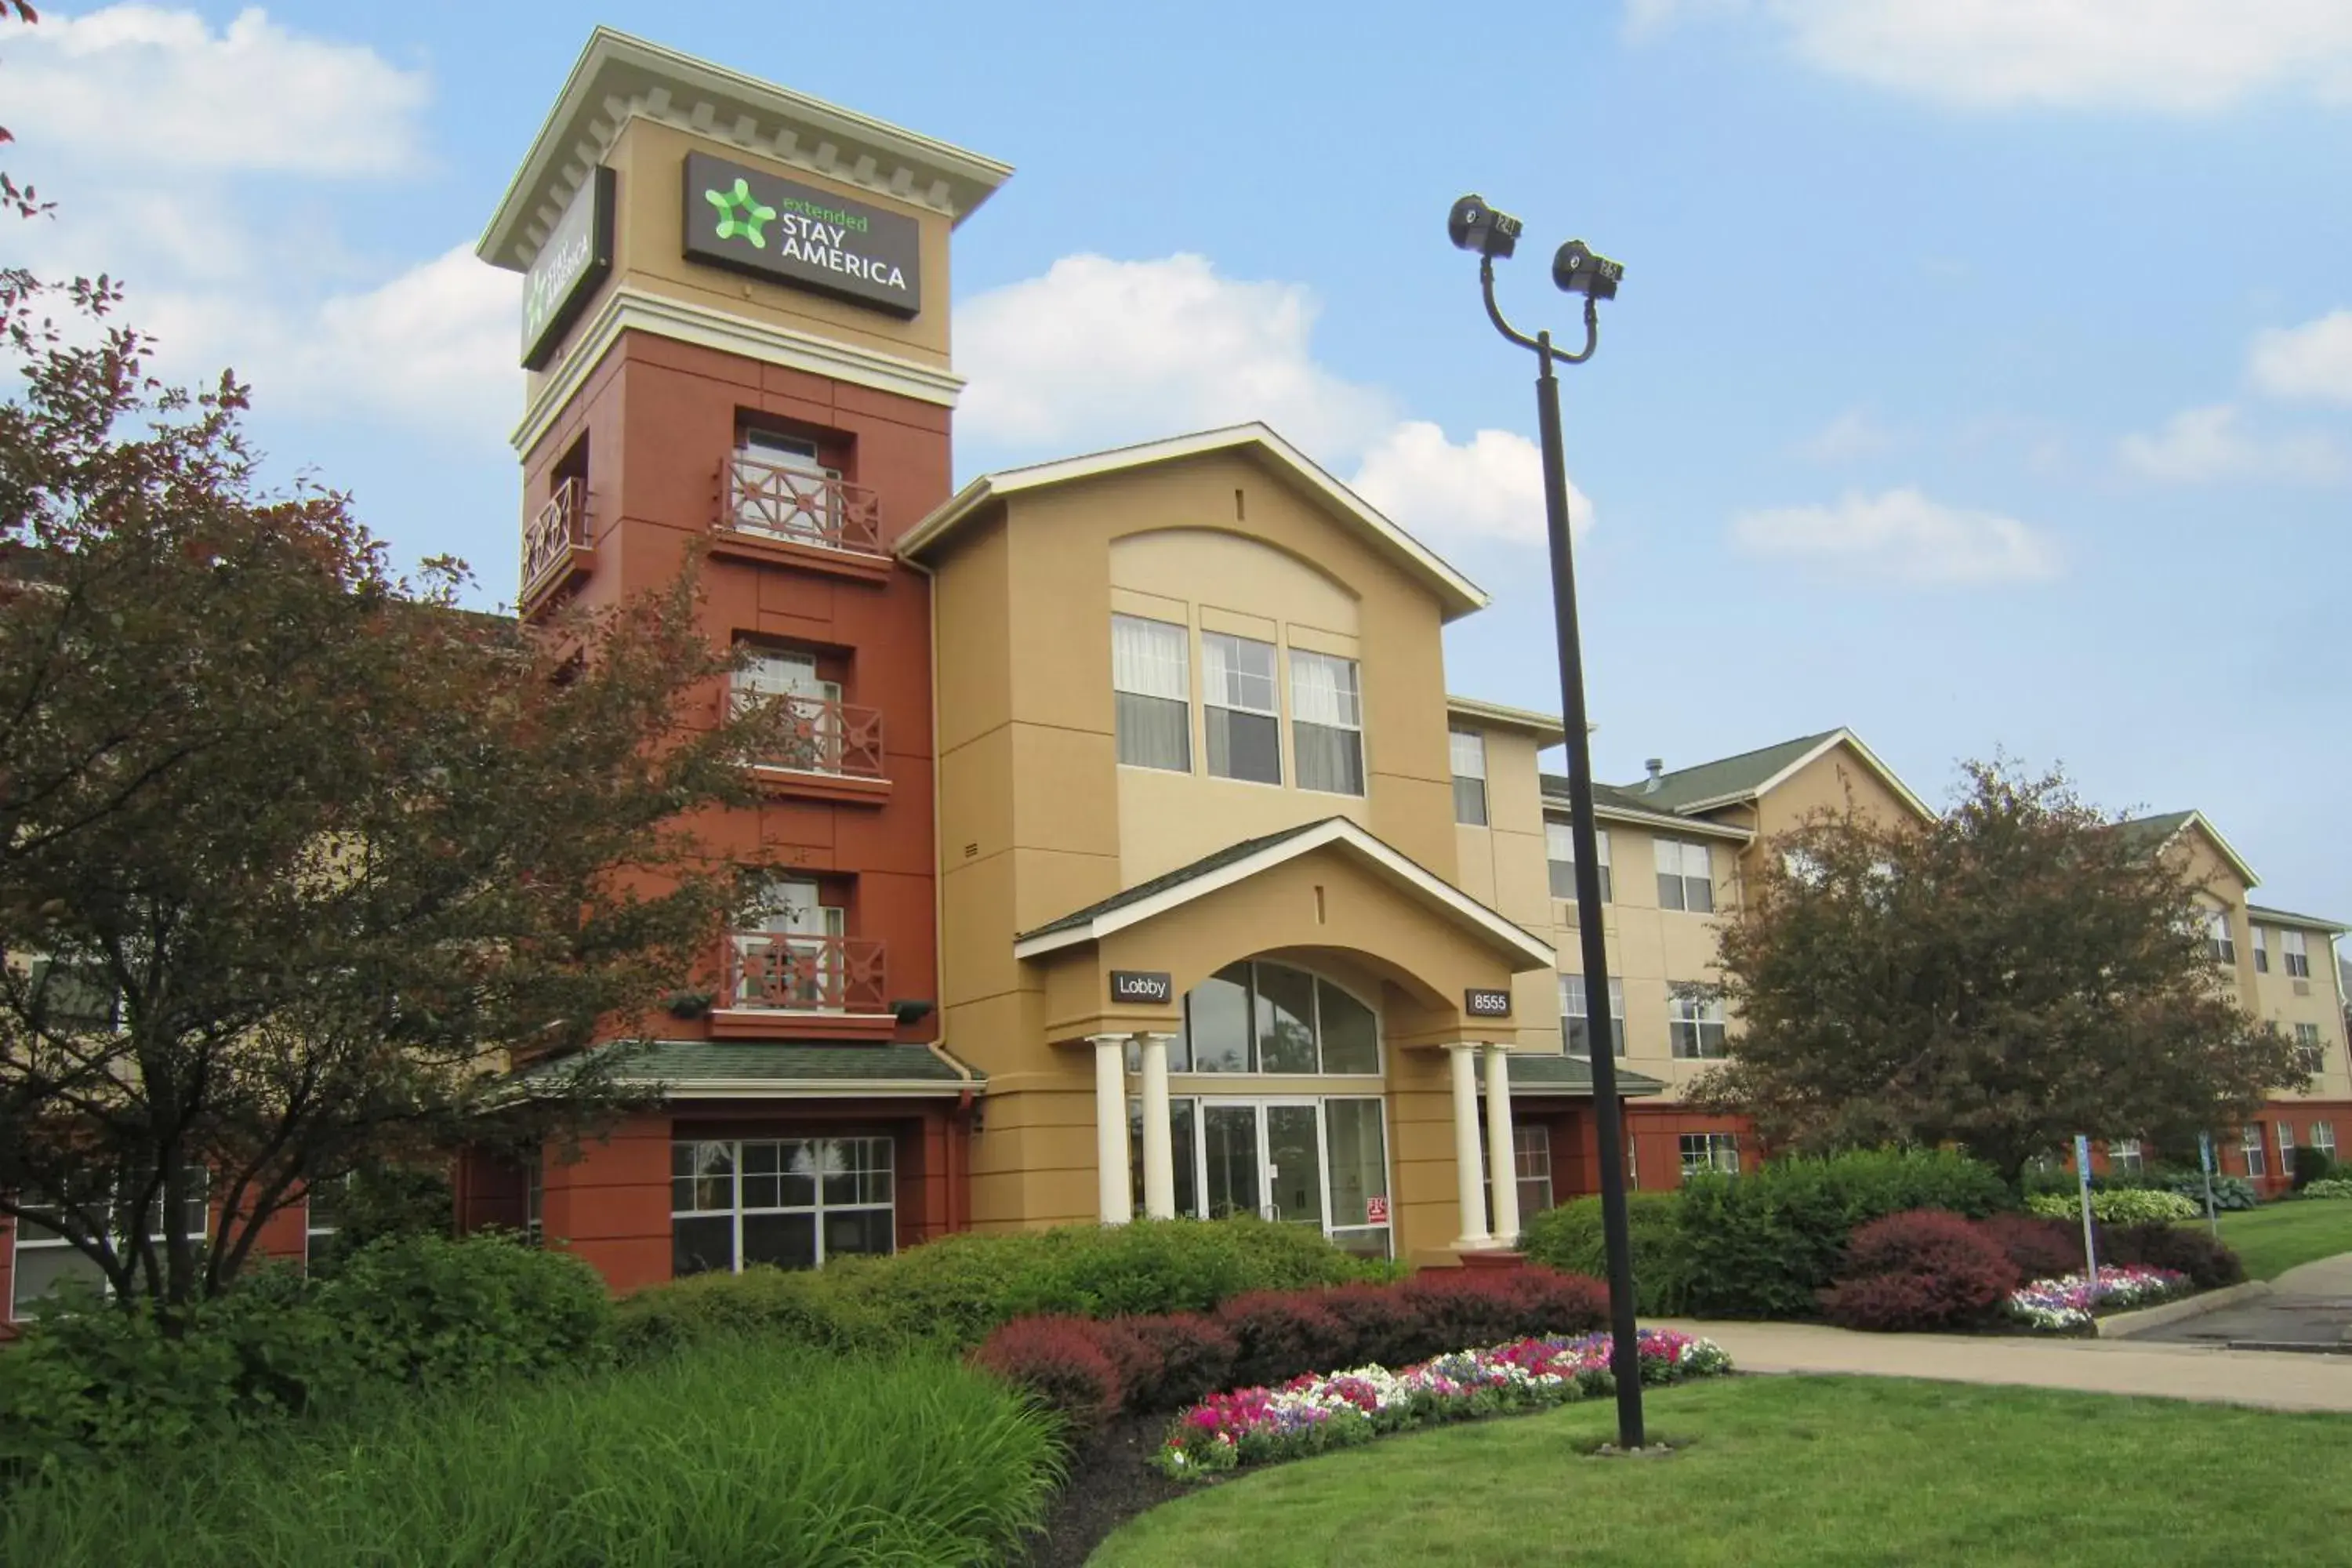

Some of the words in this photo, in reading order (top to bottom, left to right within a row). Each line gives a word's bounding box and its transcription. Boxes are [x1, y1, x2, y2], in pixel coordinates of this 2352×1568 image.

[782, 212, 846, 249] STAY
[783, 197, 868, 233] extended
[781, 237, 907, 291] AMERICA
[1120, 975, 1166, 998] Lobby
[1475, 993, 1506, 1010] 8555
